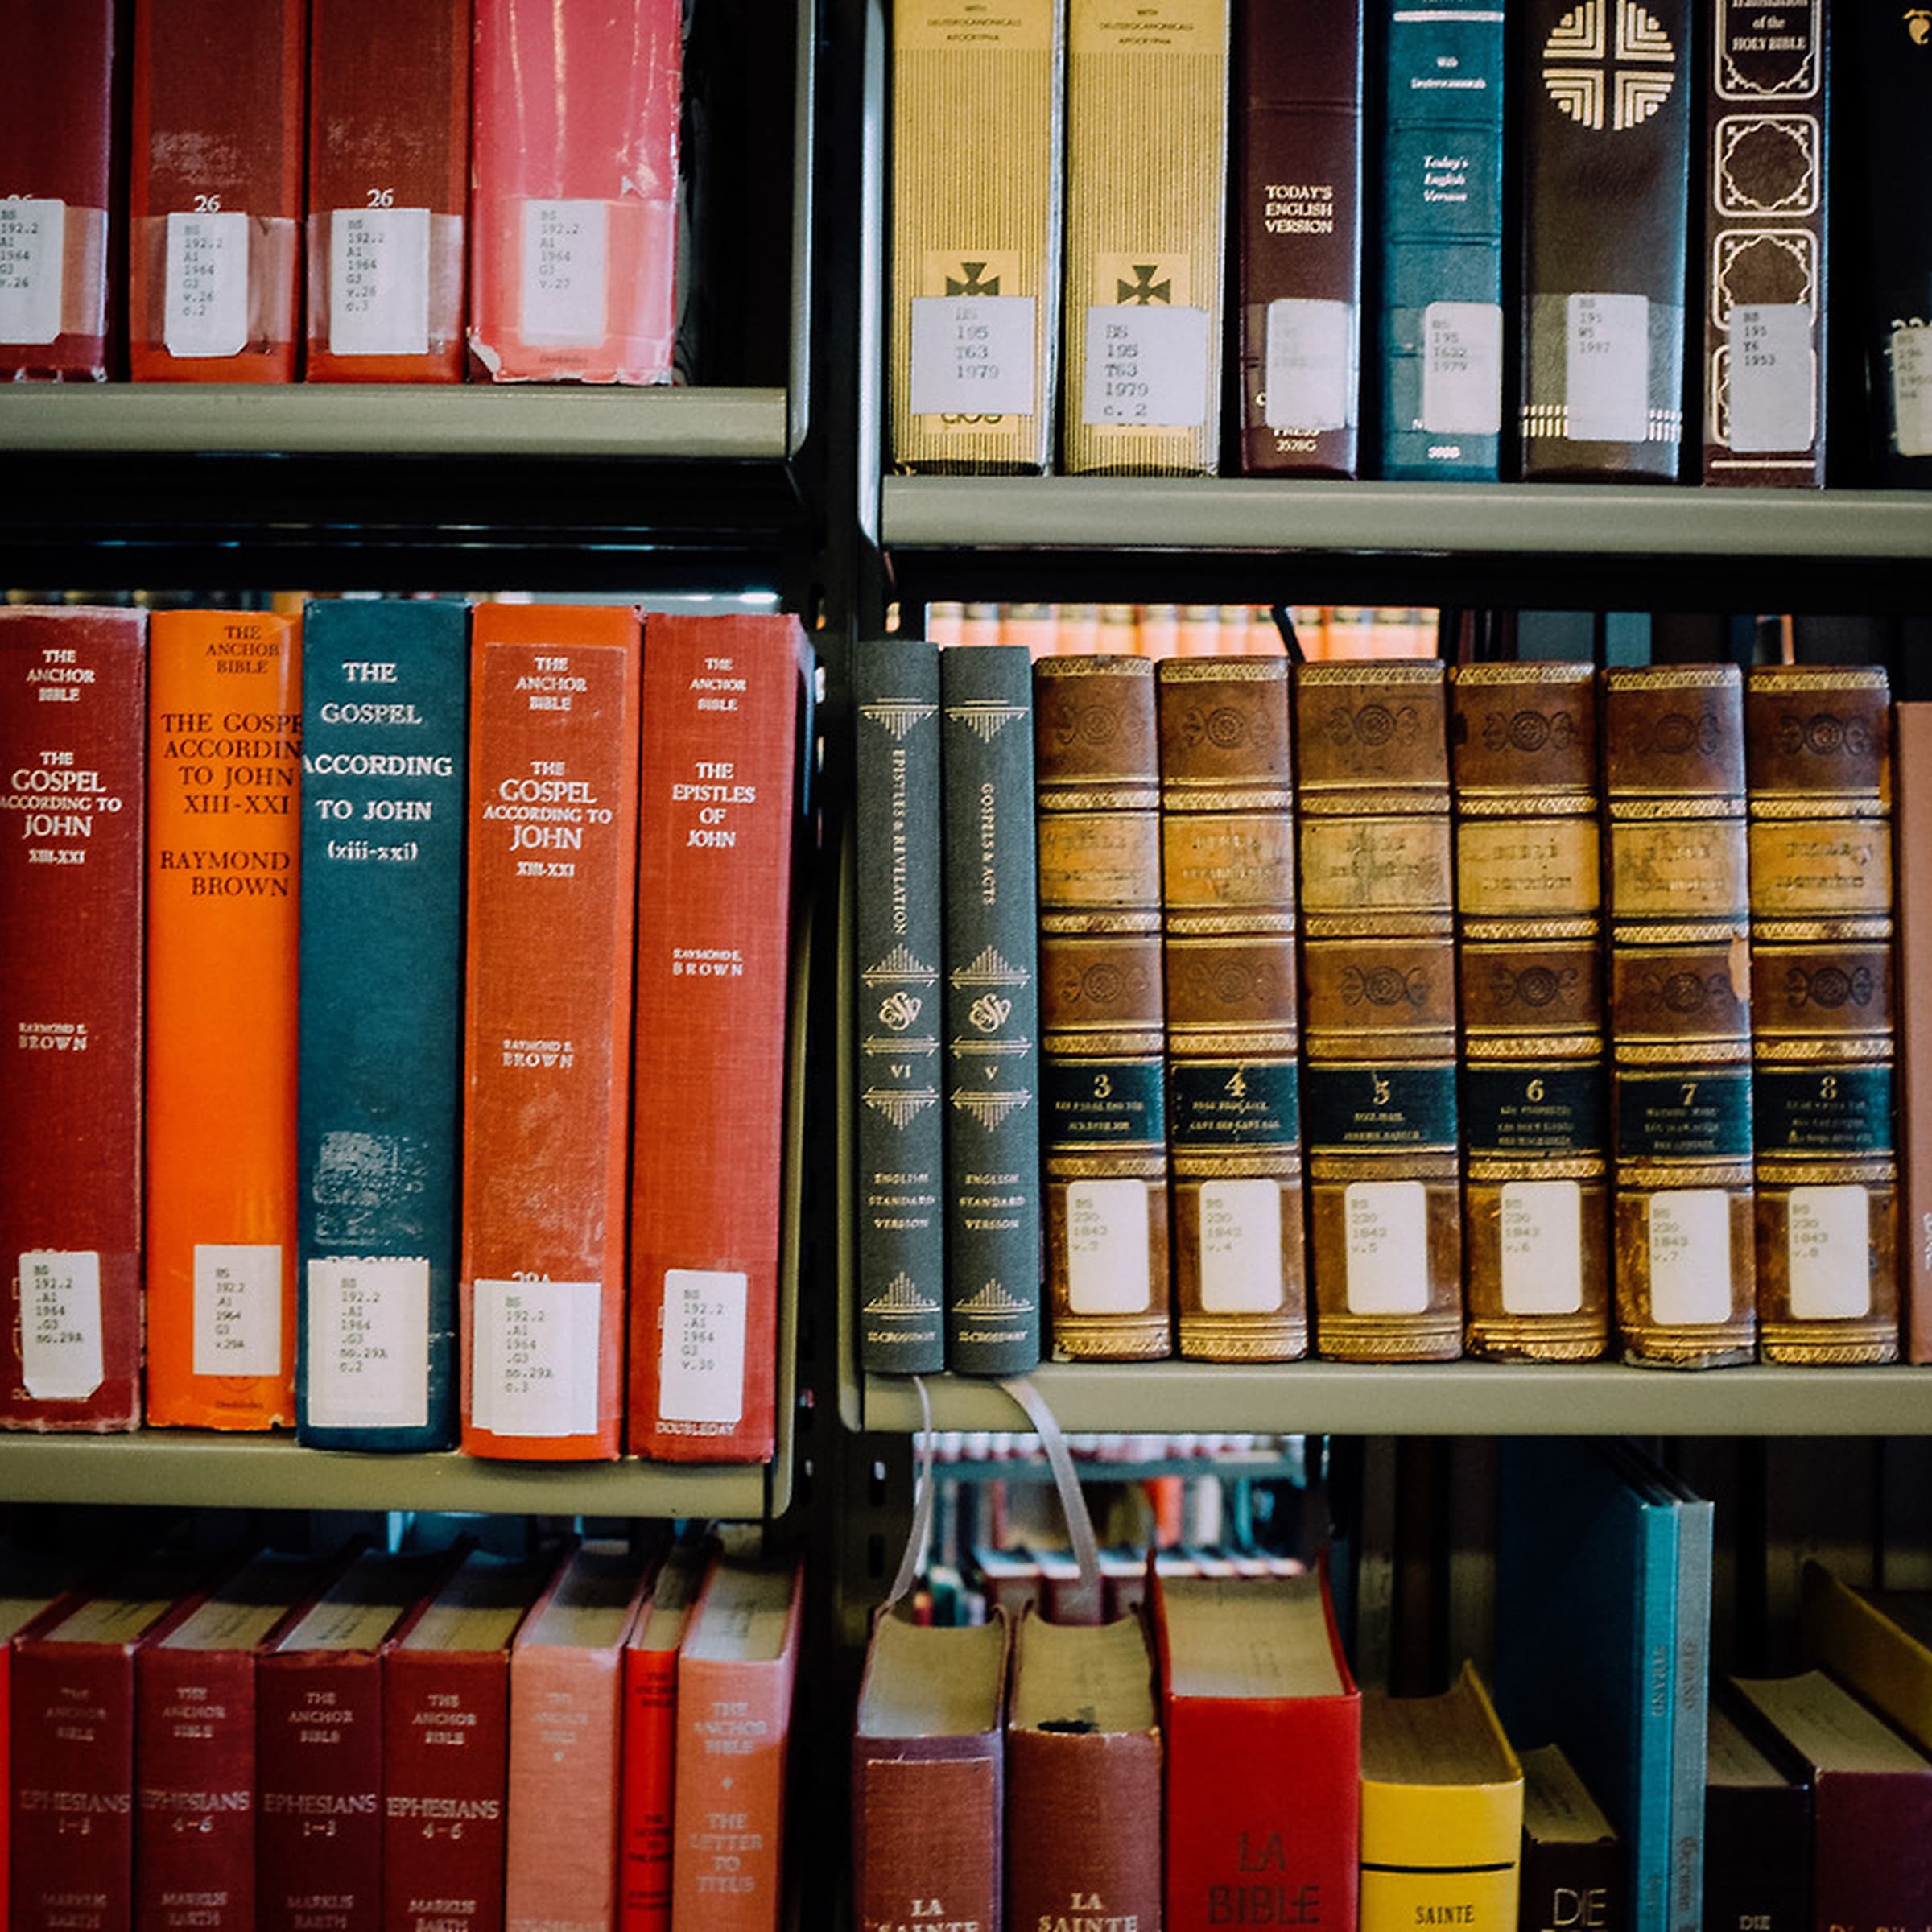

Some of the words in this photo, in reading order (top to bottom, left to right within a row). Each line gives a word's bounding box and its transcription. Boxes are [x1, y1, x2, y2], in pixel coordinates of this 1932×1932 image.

[1732, 36, 1767, 51] HOLY
[1768, 36, 1806, 51] BIBLE
[367, 188, 394, 208] 26
[1265, 184, 1333, 200] TODAY'S
[194, 194, 221, 213] 26
[1265, 201, 1333, 217] ENGLISH
[1265, 219, 1333, 234] VERSION
[956, 325, 989, 341] 195
[1106, 344, 1139, 359] 195
[956, 365, 1000, 380] 1979
[1104, 382, 1149, 398] 1979
[224, 625, 262, 640] THE
[43, 649, 76, 663] THE
[205, 643, 280, 657] ANCHOR
[217, 660, 269, 675] BIBLE
[342, 660, 398, 683] THE
[534, 656, 568, 671] THE
[704, 657, 732, 671] THE
[27, 668, 95, 683] ANCHOR
[514, 675, 588, 692] ANCHOR
[689, 678, 746, 692] ANCHOR
[39, 688, 80, 702] BIBLE
[529, 696, 572, 712] BIBLE
[697, 697, 738, 712] BIBLE
[321, 702, 423, 725] GOSPEL
[161, 712, 212, 734] THE
[223, 712, 302, 734] GOSPE
[163, 739, 302, 761] ACCORDIN
[40, 752, 73, 766] THE
[302, 754, 452, 778] ACCORDING
[530, 761, 566, 776] THE
[695, 762, 734, 779] THE
[11, 769, 106, 793] GOSPEL
[179, 766, 213, 786] TO
[224, 766, 294, 791] JOHN
[892, 749, 906, 819] EPISTLES
[499, 779, 597, 803] GOSPEL
[672, 785, 756, 803] EPISTLES
[0, 796, 91, 812] ACCORDING
[96, 798, 122, 812] TO
[184, 795, 290, 815] XIII-XXI
[316, 799, 353, 820] TO
[362, 799, 432, 822] JOHN
[483, 806, 582, 823] ACCORDING
[587, 808, 613, 824] TO
[700, 808, 726, 824] OF
[980, 782, 996, 851] GOSPELS
[22, 814, 94, 840] JOHN
[510, 825, 584, 852] JOHN
[687, 831, 737, 848] JOHN
[160, 850, 290, 872] RAYMOND
[192, 876, 289, 898] BROWN
[892, 834, 907, 935] REVELATION
[982, 865, 997, 906] ACTS
[672, 961, 743, 976] BROWN
[19, 1035, 88, 1051] BROWN
[502, 1052, 575, 1070] BROWN
[890, 1064, 911, 1078] VI
[985, 1065, 999, 1080] V
[1093, 1074, 1112, 1099] 3
[1224, 1071, 1248, 1098] 4
[1373, 1080, 1391, 1106] 5
[1526, 1078, 1545, 1103] 6
[1819, 1075, 1838, 1100] 8
[1680, 1083, 1699, 1106] 7
[874, 1173, 930, 1185] ENGLISH
[965, 1173, 1020, 1185] ENGLISH
[868, 1195, 936, 1208] STANDARD
[959, 1195, 1026, 1208] STANDARD
[873, 1218, 930, 1229] VERSION
[964, 1218, 1020, 1230] VERSION
[655, 1421, 736, 1436] DOUBLEDAY
[427, 1694, 459, 1707] THE
[712, 1702, 749, 1716] THE
[288, 1711, 353, 1724] ANCHOR
[412, 1712, 477, 1725] ANCHOR
[20, 1790, 130, 1814] EPHESIANS
[142, 1789, 250, 1811] EPHESIANS
[264, 1794, 377, 1813] EPHESIANS
[386, 1796, 500, 1820] EPHESIANS
[708, 1813, 748, 1829] THE
[690, 1834, 763, 1850] LETTER
[1239, 1832, 1287, 1872] LA
[910, 1898, 945, 1917] LA
[1071, 1893, 1103, 1910] LA
[1208, 1885, 1319, 1926] BIBLE
[1553, 1888, 1607, 1926] DIE
[1038, 1915, 1138, 1932] SAINTE
[1415, 1905, 1475, 1925] SAINTE
[1739, 1915, 1771, 1930] DIE
